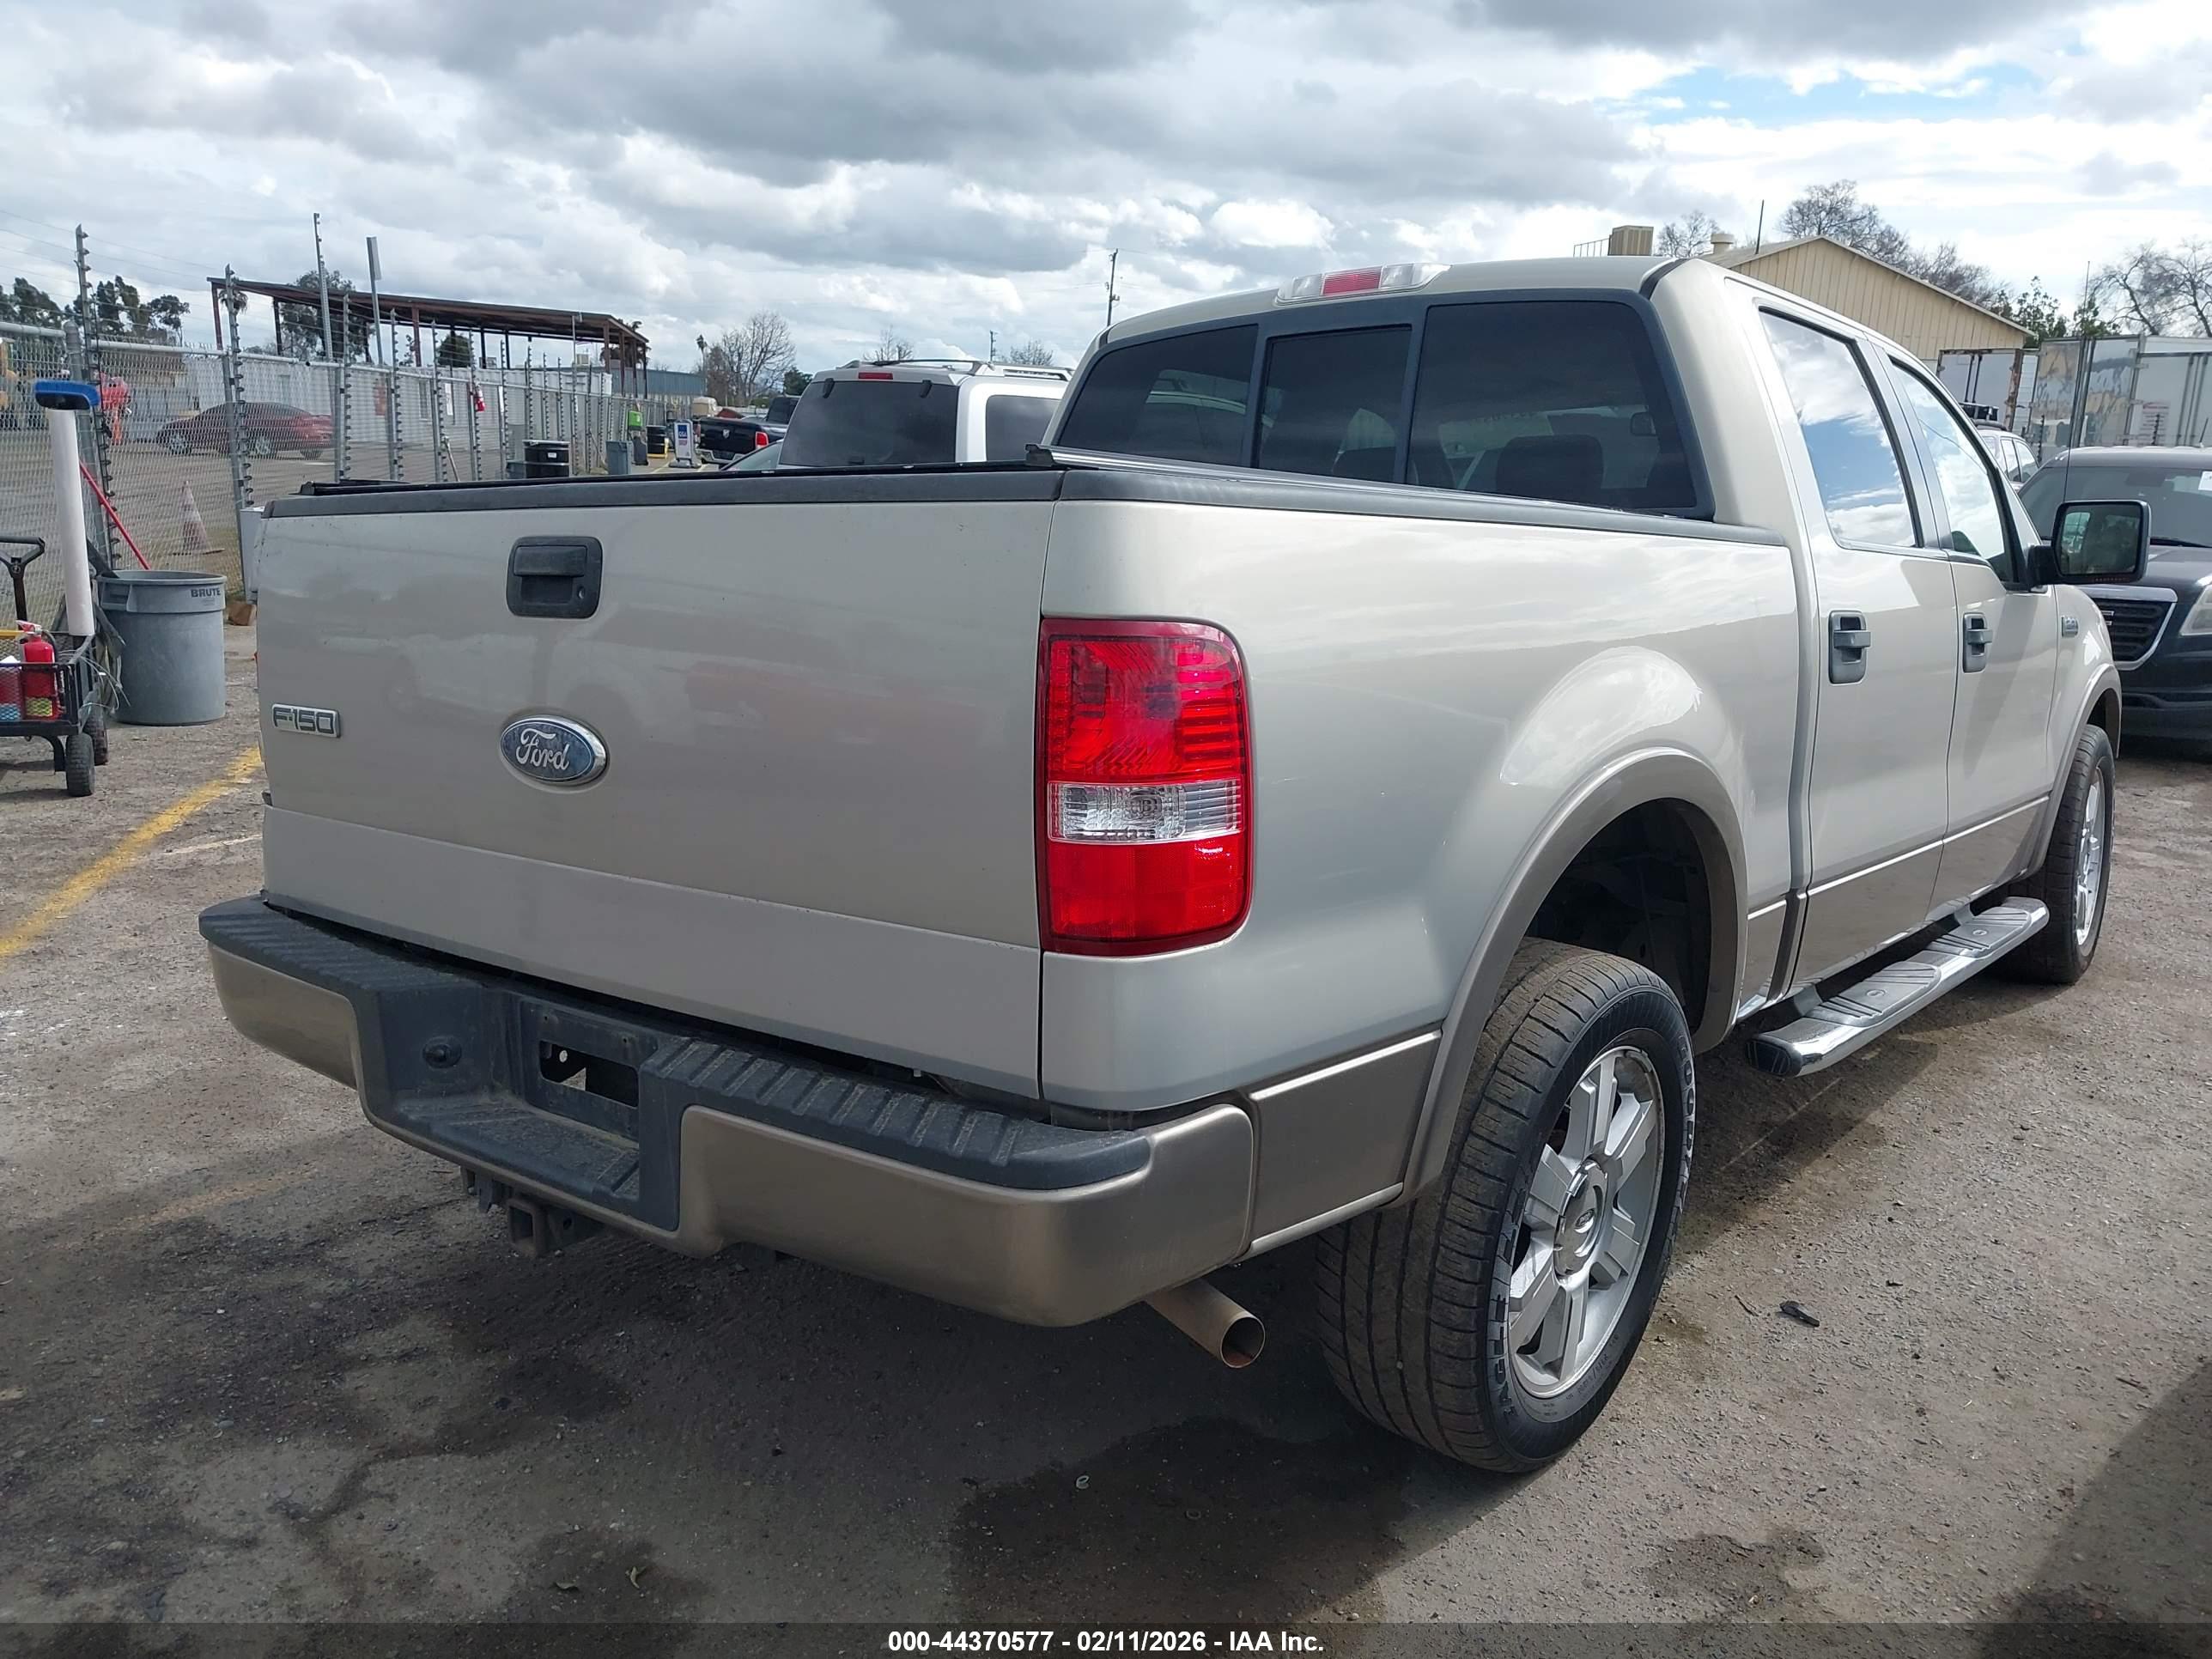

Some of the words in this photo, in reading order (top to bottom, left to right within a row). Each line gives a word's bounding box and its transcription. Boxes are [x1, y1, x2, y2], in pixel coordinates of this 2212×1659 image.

[191, 587, 221, 598] BRUTE
[272, 705, 336, 736] F-150
[516, 727, 570, 771] Ford
